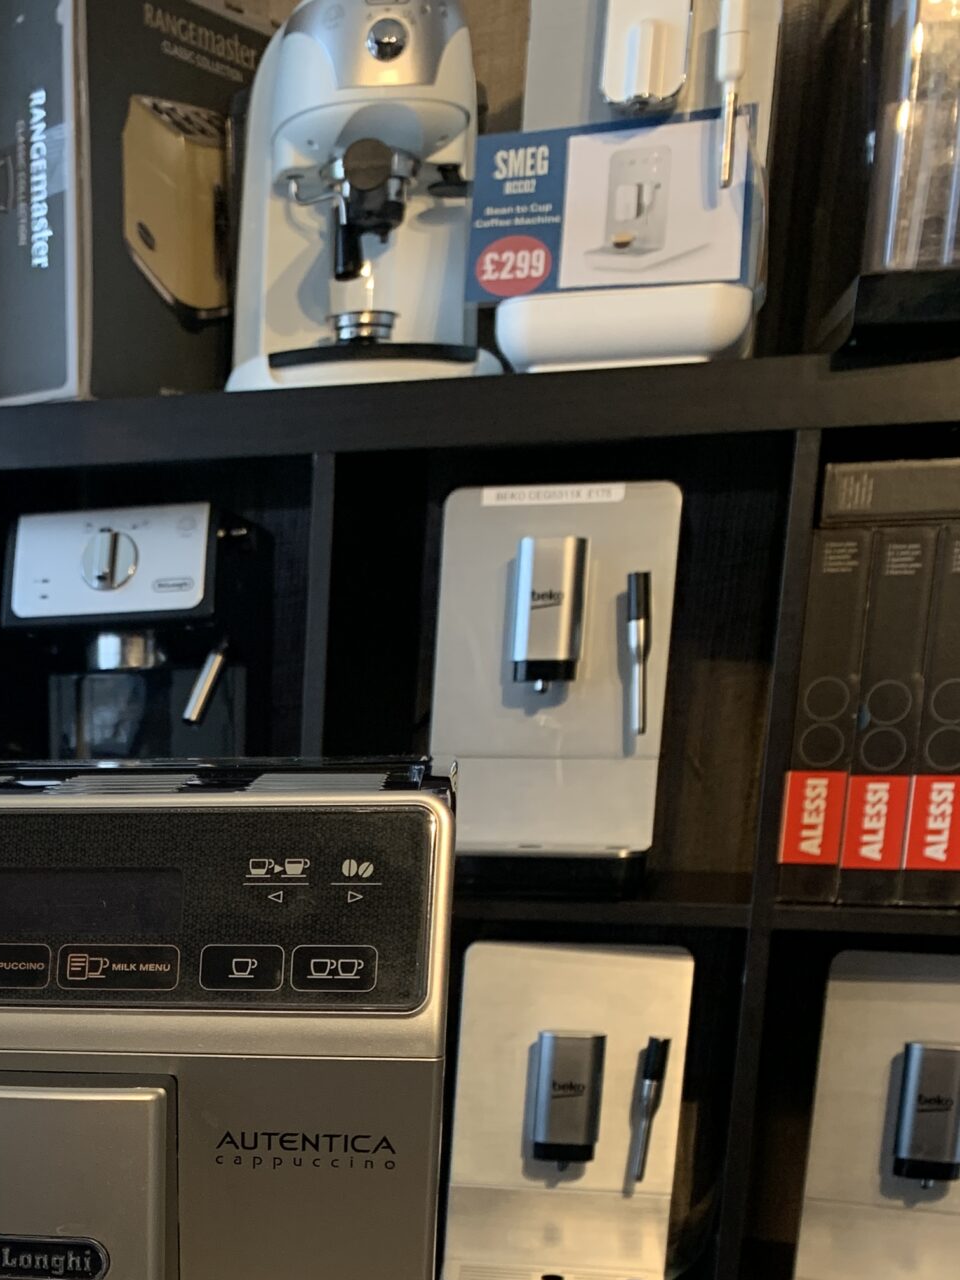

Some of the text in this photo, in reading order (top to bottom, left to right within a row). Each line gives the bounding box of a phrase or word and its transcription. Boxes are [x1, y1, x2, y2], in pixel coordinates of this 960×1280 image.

[143, 2, 257, 70] RANGEmaster
[29, 88, 54, 269] RANGEmaster
[493, 145, 550, 180] SMEG
[474, 214, 561, 229] Coffee Machine
[485, 203, 553, 216] Bean to Cup
[482, 248, 547, 281] £299
[799, 777, 829, 857] ALESSI
[859, 782, 890, 861] ALESSI
[923, 782, 956, 862] ALESSI
[111, 962, 171, 972] MILK MENU
[216, 1130, 397, 1156] AUTENTICA
[215, 1152, 397, 1171] cappuccino
